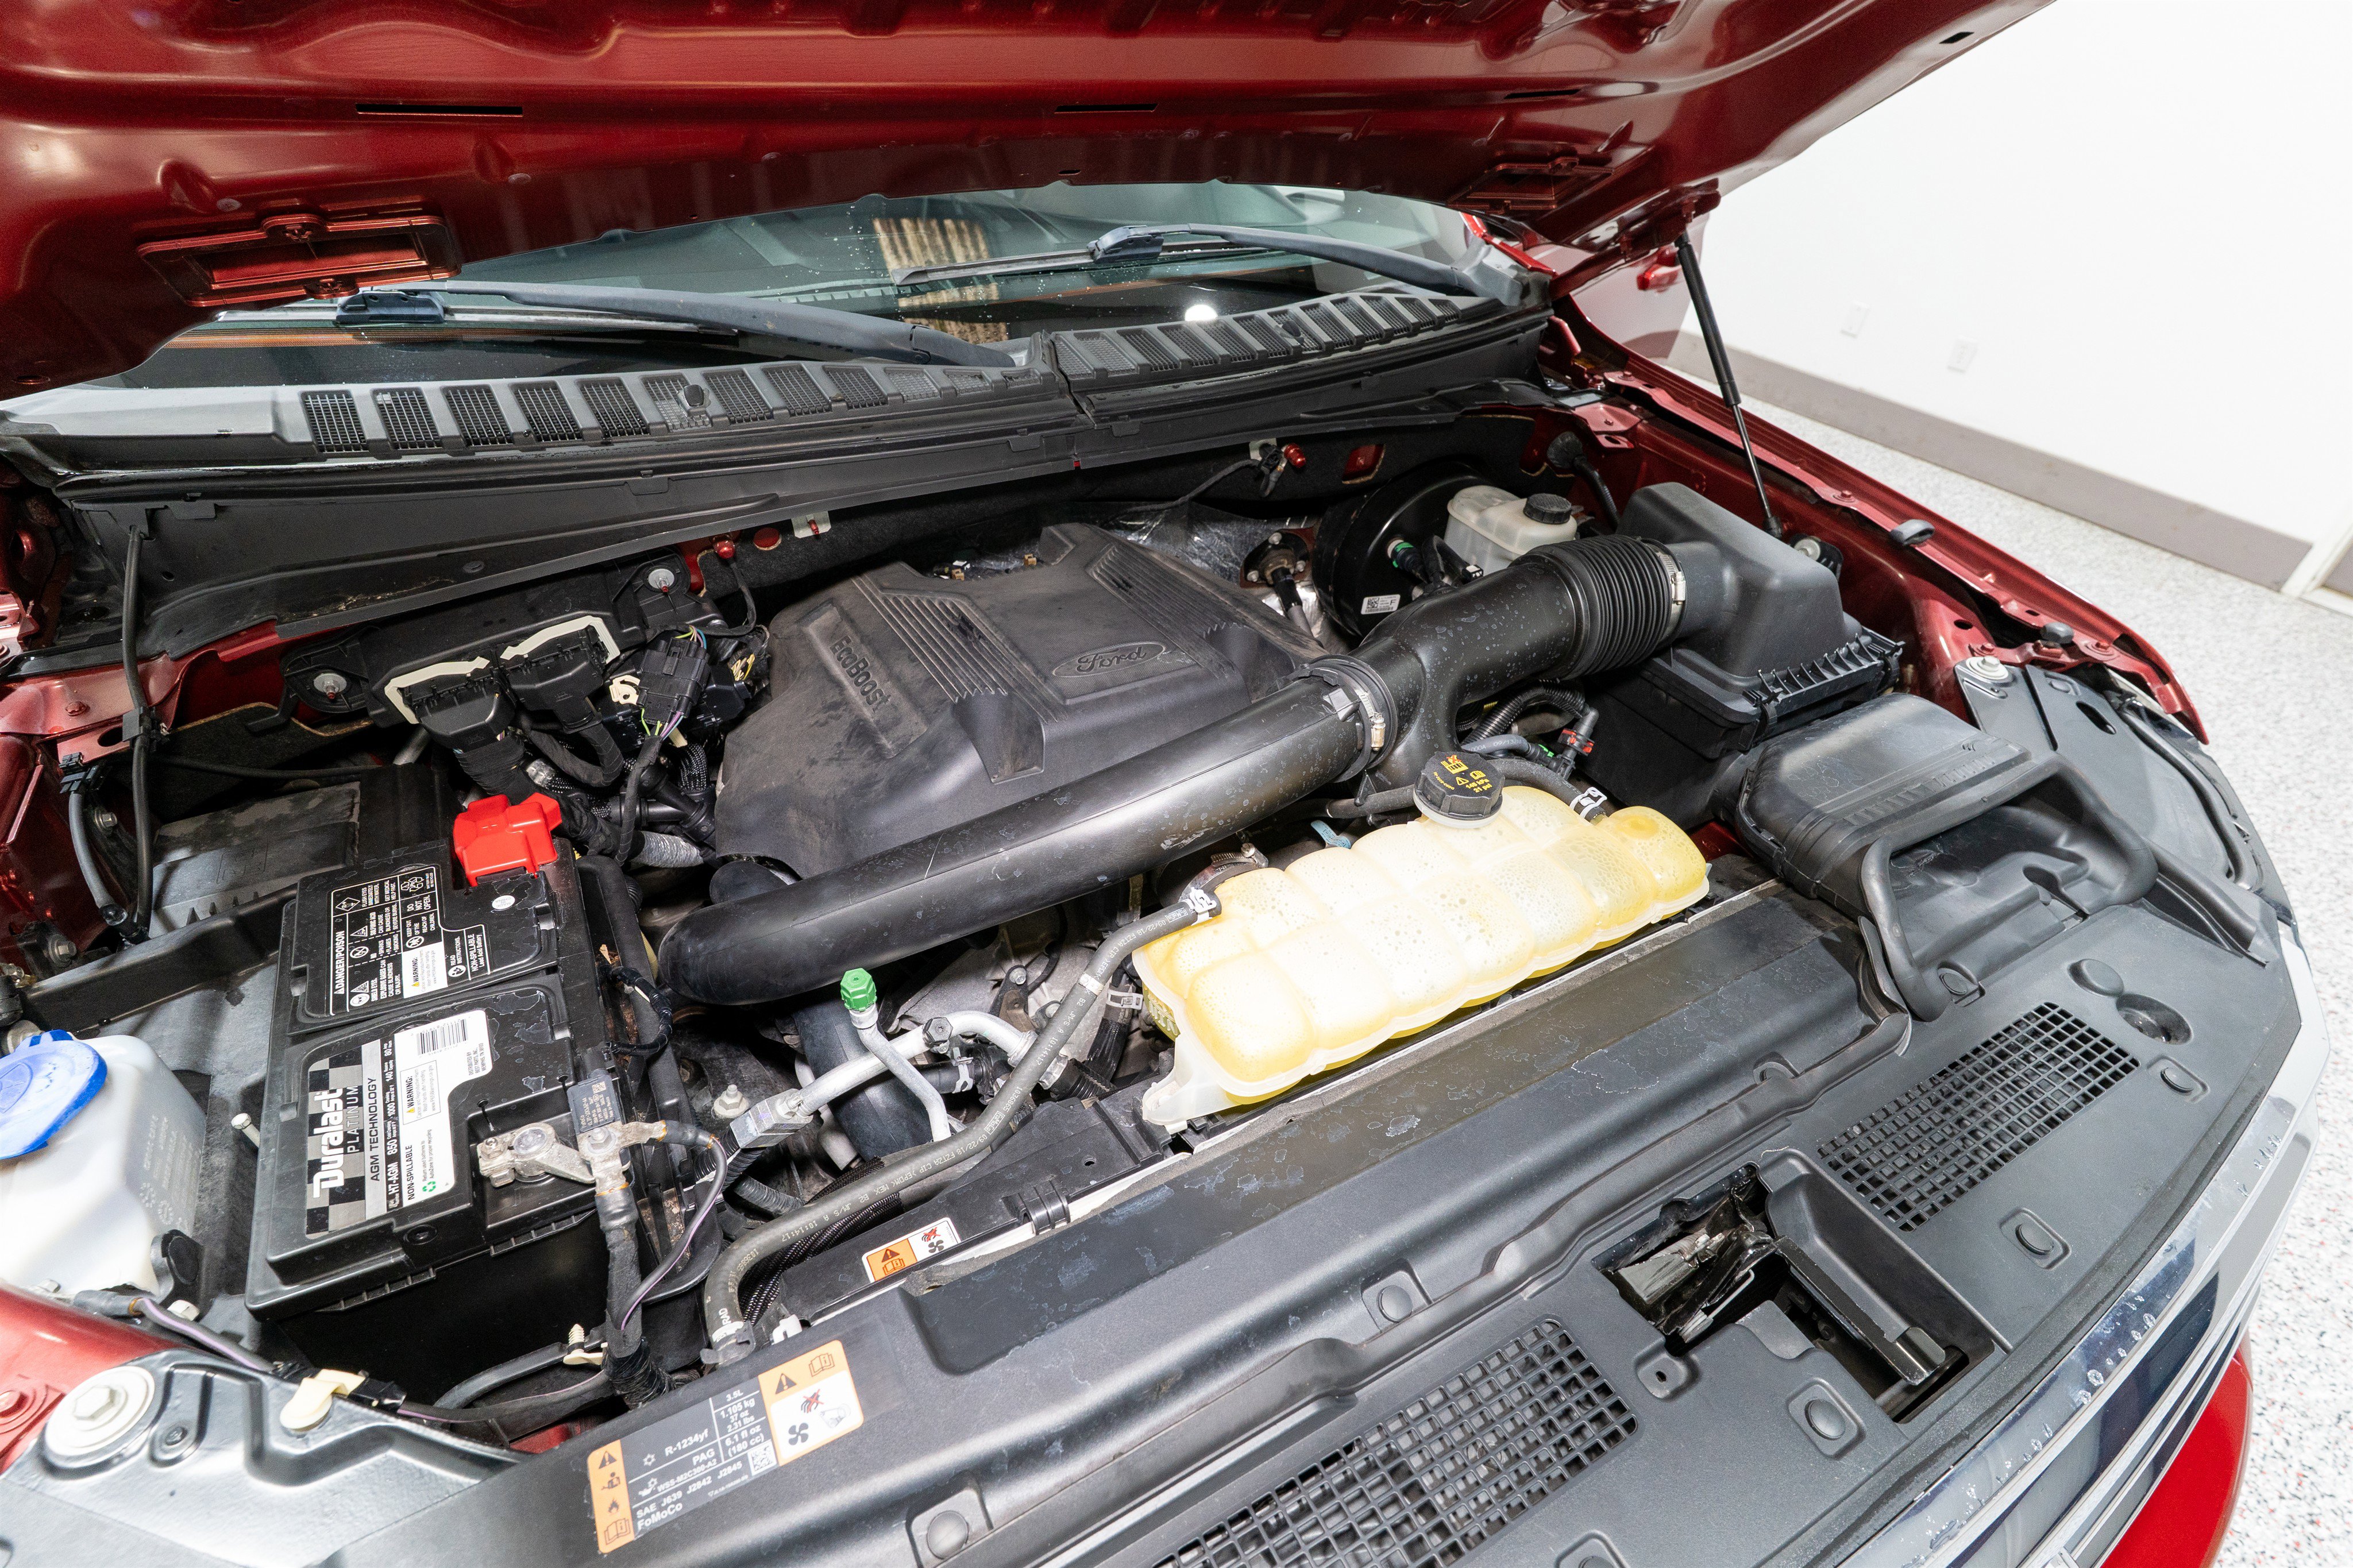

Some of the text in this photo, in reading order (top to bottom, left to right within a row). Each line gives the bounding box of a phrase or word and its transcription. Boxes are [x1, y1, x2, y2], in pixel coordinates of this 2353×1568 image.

[1076, 646, 1147, 673] Ford
[828, 635, 891, 710] EcoBoost
[335, 931, 345, 988] DANGER/POISON
[468, 934, 478, 972] NON-SPILLABLE
[1077, 998, 1086, 1006] B2
[1036, 1037, 1059, 1066] 10:14:17
[406, 1076, 414, 1108] WARNING:
[1003, 1086, 1023, 1113] 1036865
[346, 1086, 360, 1153] PLATINUM
[387, 1103, 395, 1117] 1000
[368, 1077, 379, 1181] AGM TECHNOLOGY
[313, 1088, 345, 1198] Duralast
[387, 1139, 398, 1155] 850
[956, 1134, 988, 1155] 09/22/18
[387, 1162, 399, 1195] H7-AGM
[406, 1145, 415, 1200] NON-SPILLABLE
[858, 1195, 869, 1203] B2
[874, 1183, 890, 1196] MEX
[781, 1220, 819, 1242] 10:14:17
[719, 1308, 731, 1326] RAD
[726, 1389, 744, 1402] 3.5L
[720, 1399, 755, 1418] 1.105 kg
[730, 1410, 749, 1423] 37 oz
[726, 1425, 761, 1446] 6.1 fl oz
[727, 1416, 754, 1432] 2.31 lbs
[665, 1428, 708, 1457] R-1234yf
[728, 1433, 764, 1457] (180 cc)
[692, 1448, 715, 1465] PAG
[637, 1503, 657, 1518] SAE
[661, 1490, 682, 1507] J639
[686, 1476, 712, 1494] J2842
[718, 1461, 742, 1479] J2845
[637, 1503, 683, 1531] FoMoCo
